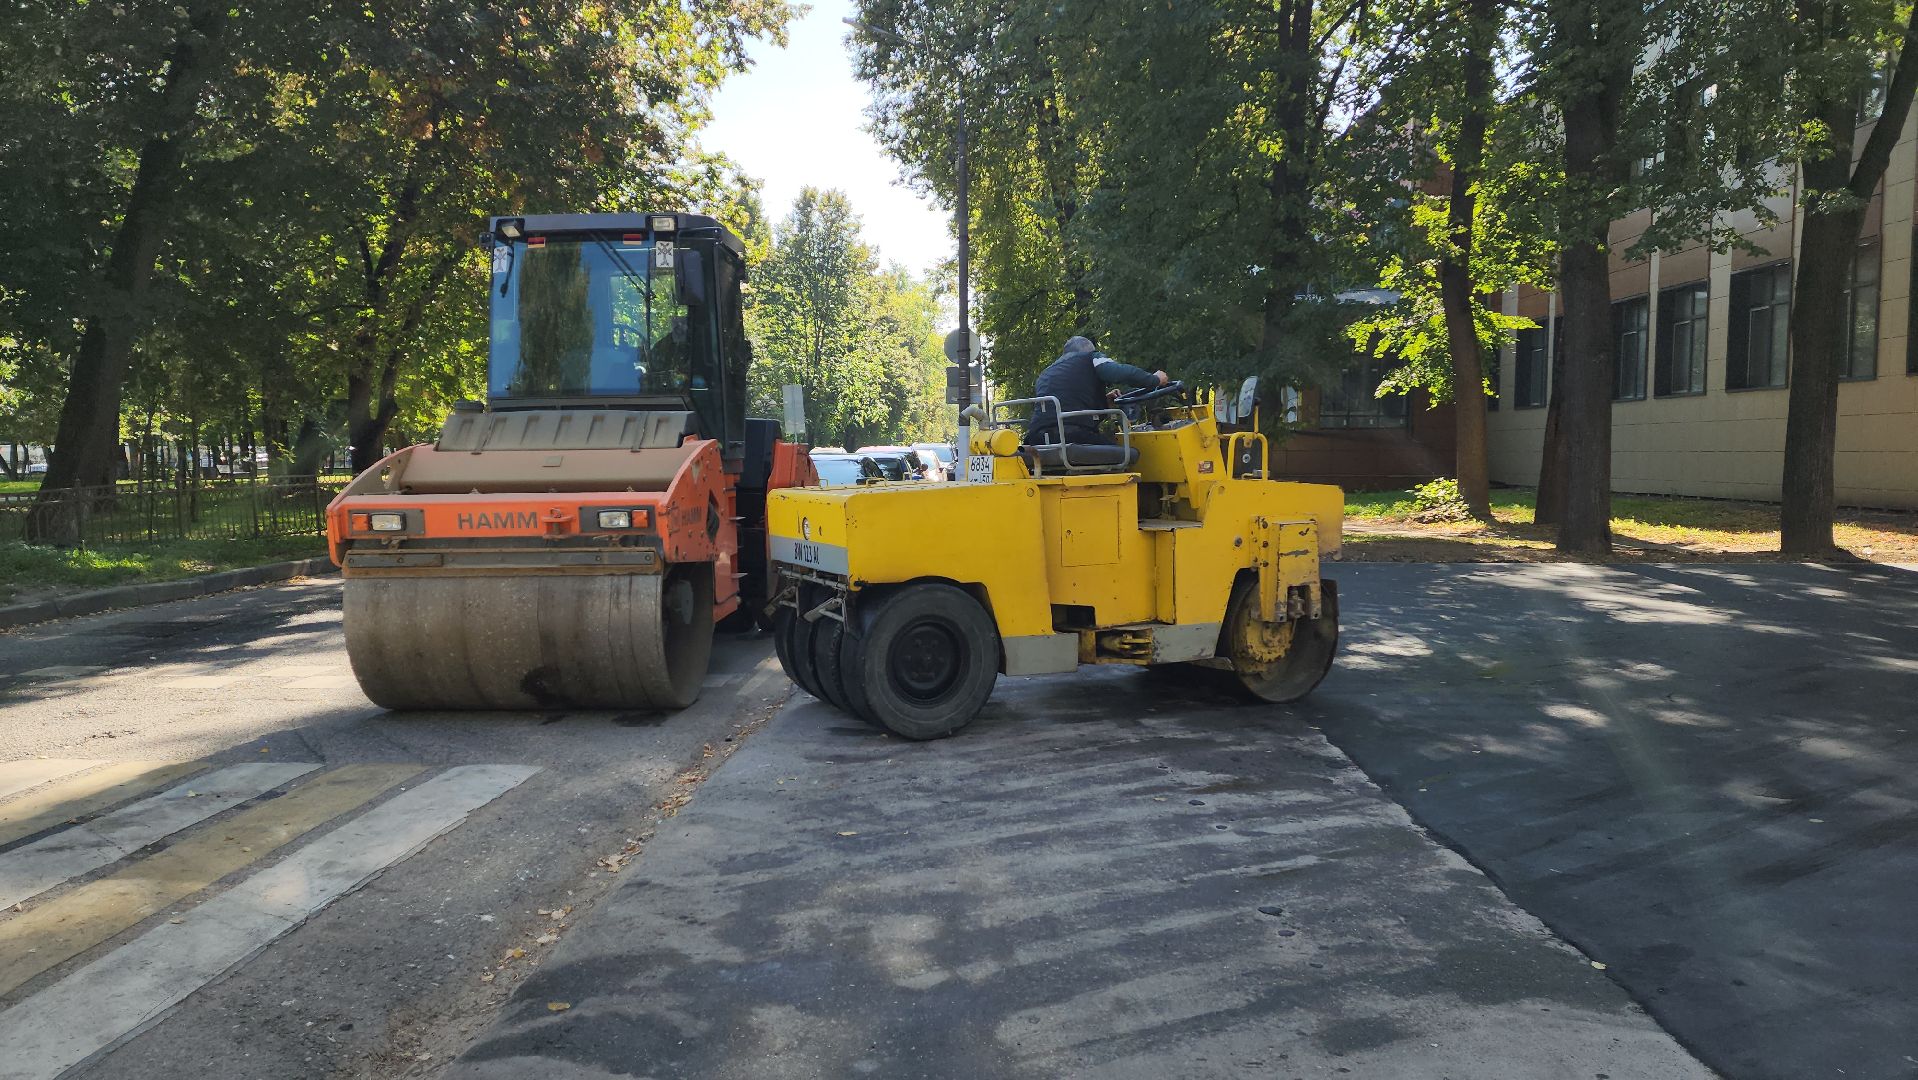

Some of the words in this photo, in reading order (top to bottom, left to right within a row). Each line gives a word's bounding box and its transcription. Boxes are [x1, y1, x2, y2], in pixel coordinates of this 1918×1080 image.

[970, 456, 990, 472] 6834
[457, 511, 539, 529] HAMM
[803, 544, 813, 563] 123
